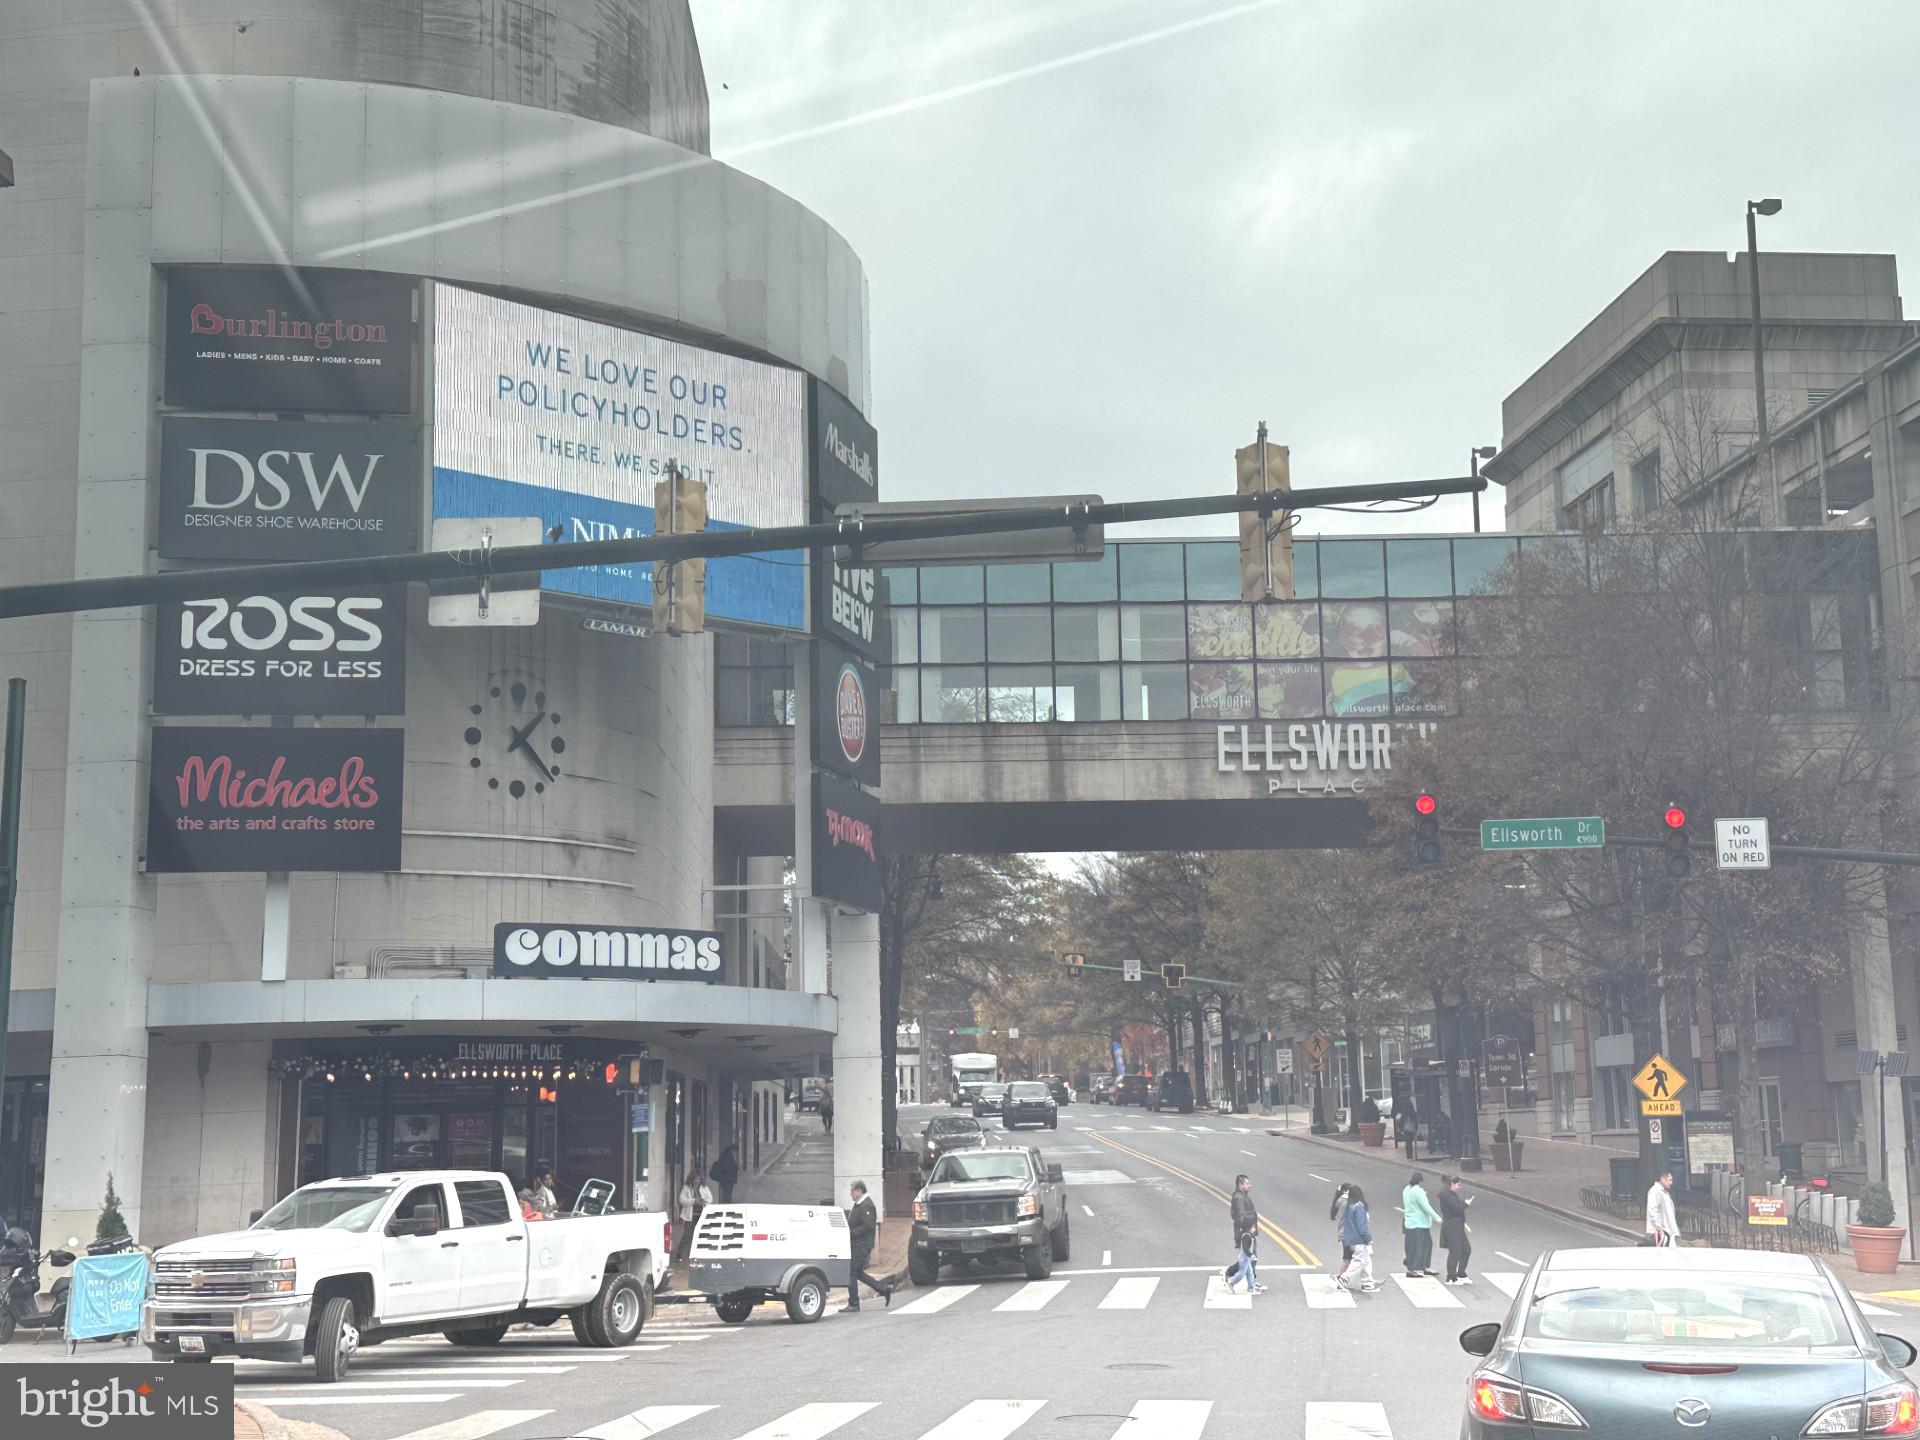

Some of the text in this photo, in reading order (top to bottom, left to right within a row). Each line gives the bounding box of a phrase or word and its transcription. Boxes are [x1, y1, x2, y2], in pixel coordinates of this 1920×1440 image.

[191, 303, 388, 349] Burlington
[196, 351, 382, 366] LADIES MENS KIDS BABY HOME COATS
[526, 340, 728, 410] WE LOVE OUR
[498, 374, 752, 453] POLICYHOLDERS.
[824, 421, 874, 488] Marshalls
[614, 450, 642, 473] WE
[649, 458, 691, 481] SAD
[186, 448, 385, 513] DSW
[184, 513, 384, 531] DESIGNER SHOE WAREHOUSE
[181, 595, 383, 651] ROSS
[832, 583, 874, 643] BELOW
[590, 619, 647, 637] LAMAR
[180, 658, 382, 678] DRESS FOR LESS
[1217, 722, 1438, 772] ELLSWOR
[175, 755, 378, 809] Michaels
[1268, 777, 1382, 794] PLAC
[176, 816, 376, 830] the arts and crafts store
[1491, 821, 1592, 842] Ellsworth Dr
[1732, 824, 1750, 835] NO
[1728, 838, 1757, 848] TURN
[1722, 852, 1765, 862] ON RED
[505, 928, 721, 971] commas
[458, 1043, 563, 1060] ELLSWORTH PLACE
[1647, 1103, 1675, 1112] AHEAD
[110, 1278, 139, 1294] Do Not
[110, 1298, 133, 1313] Enter
